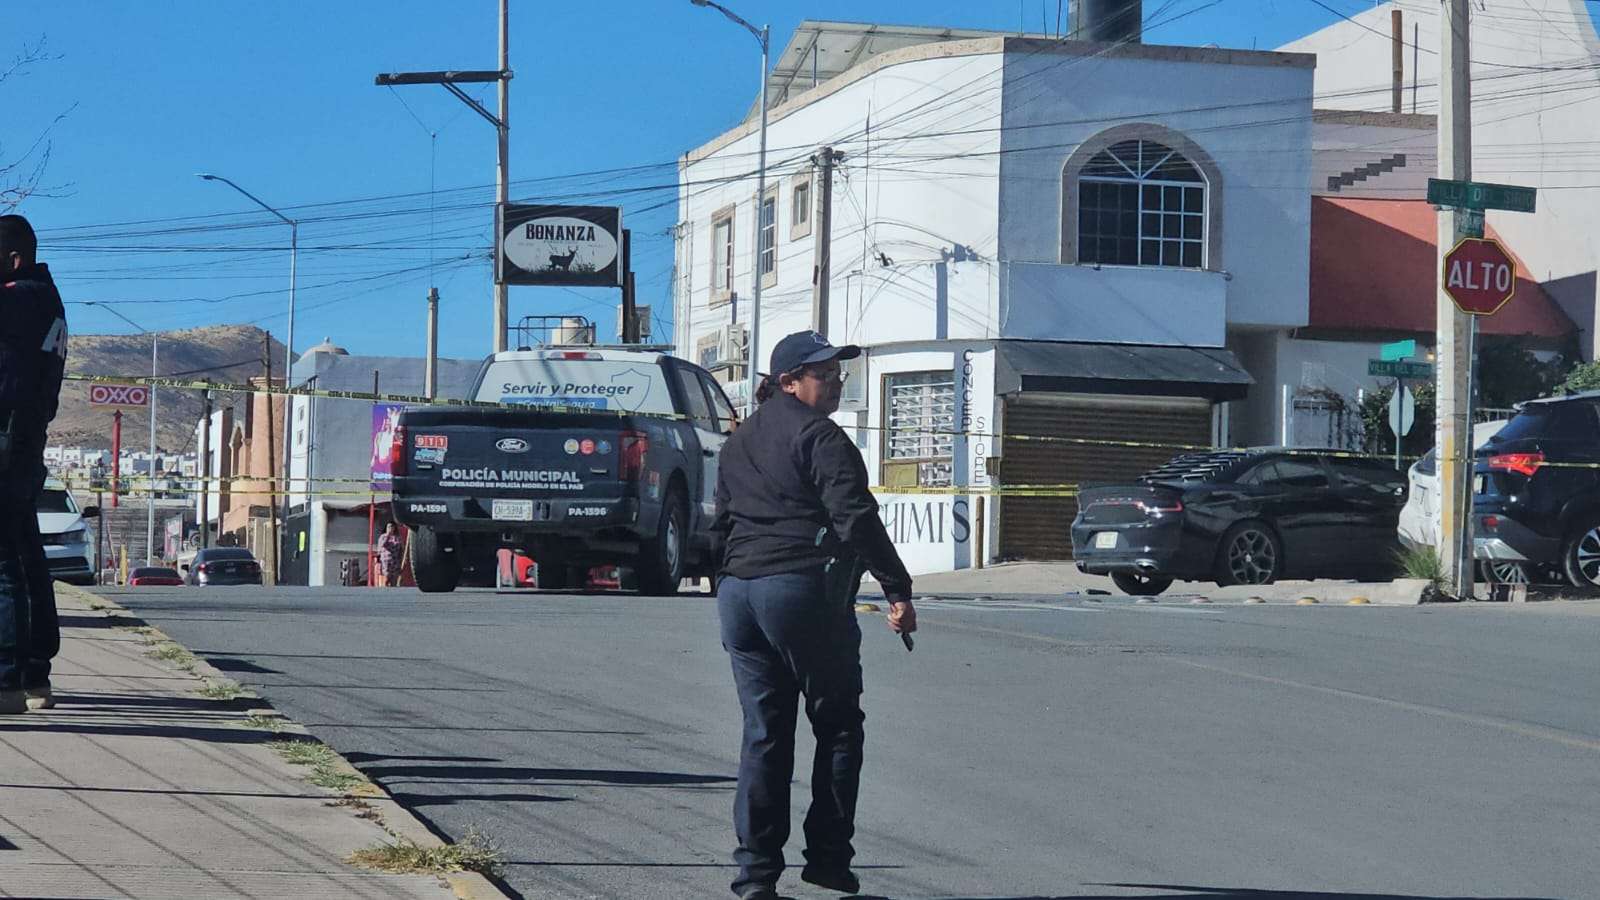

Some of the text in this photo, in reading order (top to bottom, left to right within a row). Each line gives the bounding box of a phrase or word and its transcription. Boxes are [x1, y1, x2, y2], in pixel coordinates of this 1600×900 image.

[526, 223, 595, 241] BONANZA
[1448, 260, 1510, 292] ALTO
[92, 386, 145, 404] OXXO
[502, 382, 633, 397] Servir y Proteger
[417, 437, 444, 447] 911
[499, 439, 524, 451] Ford
[975, 416, 985, 483] STORE
[442, 467, 580, 482] POLICÍA MUNICIPAL
[879, 501, 971, 544] HIMI'S
